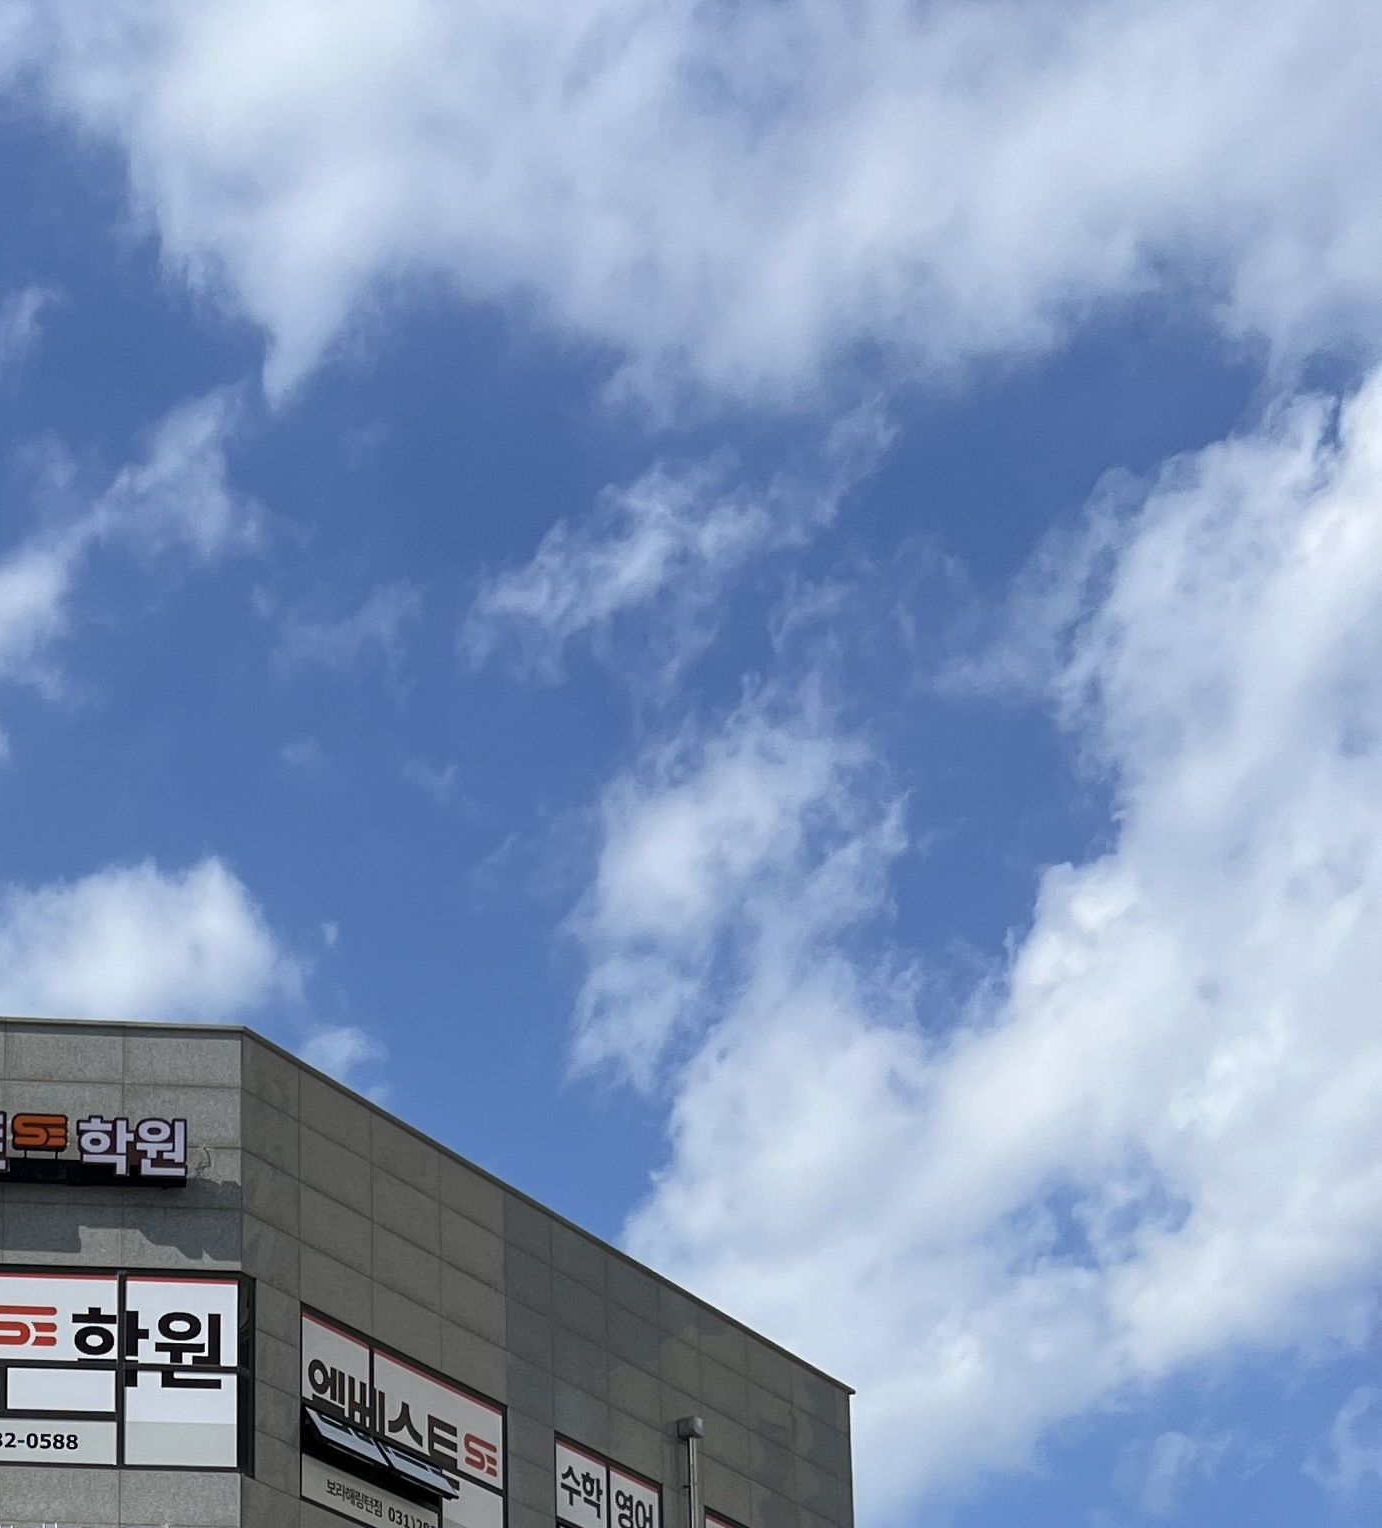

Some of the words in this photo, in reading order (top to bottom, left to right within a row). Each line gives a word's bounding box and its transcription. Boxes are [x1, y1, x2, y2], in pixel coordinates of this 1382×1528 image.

[76, 1114, 187, 1177] 학원
[70, 1307, 223, 1389] 학원
[326, 1478, 383, 1518] 보라해링턴점
[560, 1466, 603, 1520] 수학
